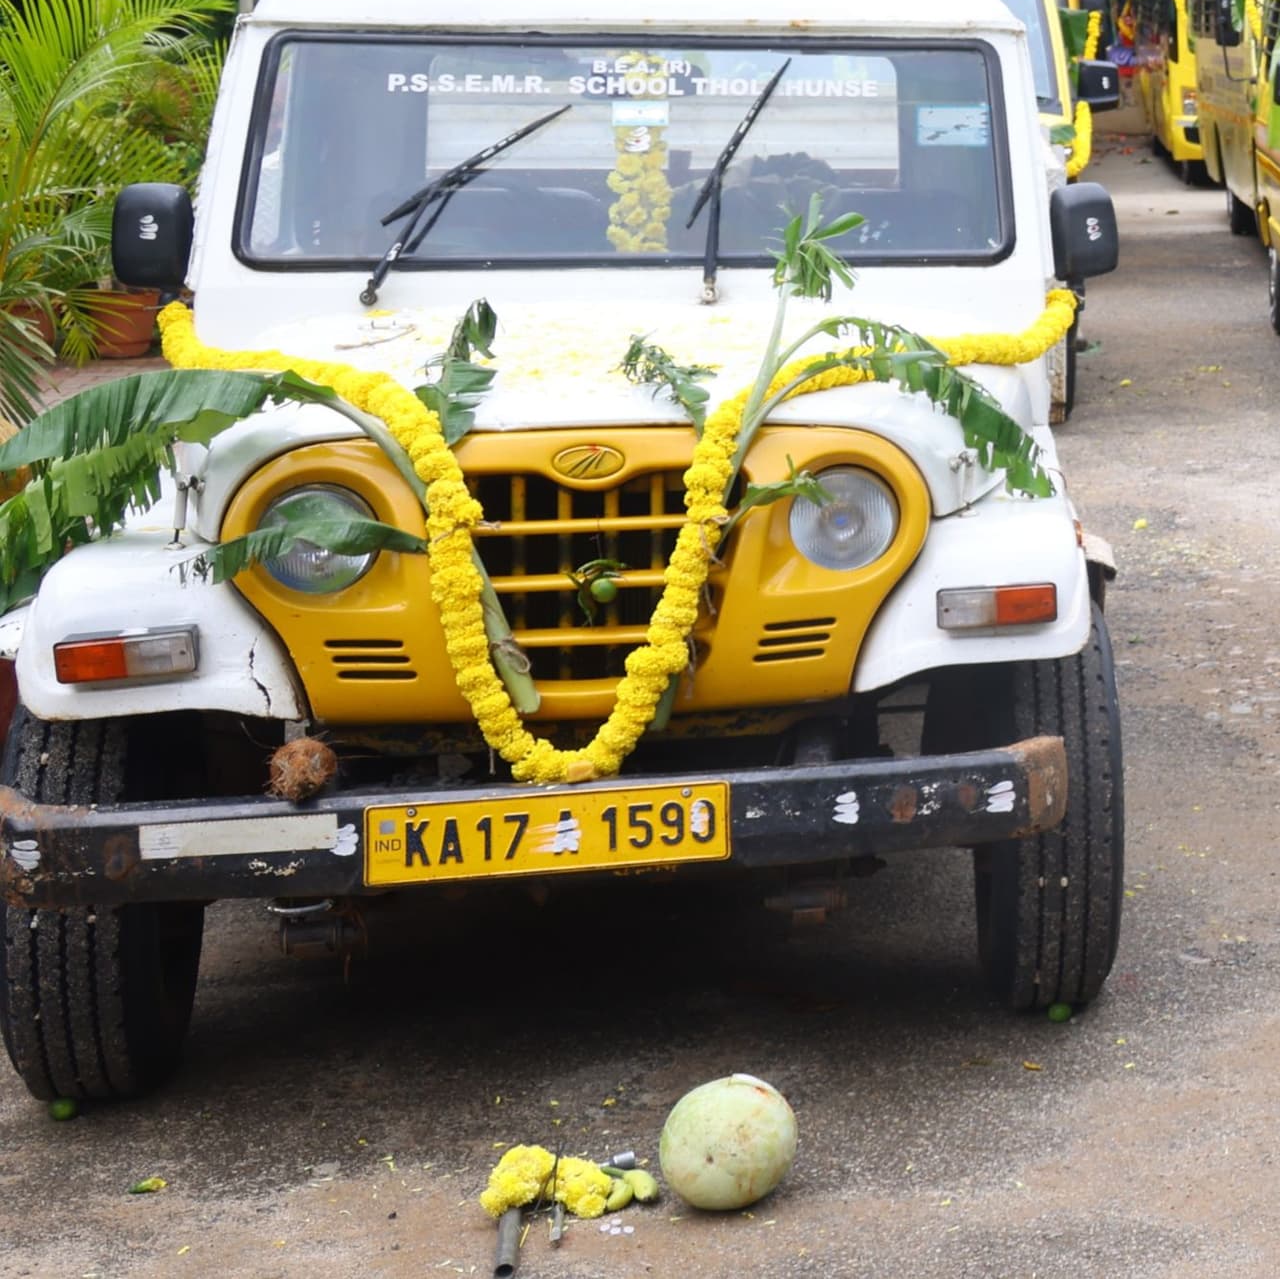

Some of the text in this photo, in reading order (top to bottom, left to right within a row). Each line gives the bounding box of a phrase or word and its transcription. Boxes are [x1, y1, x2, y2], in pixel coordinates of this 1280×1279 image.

[593, 59, 692, 76] B.E.A. (R)
[387, 73, 879, 98] P.S.S.E.M.R. SCHOOL THOLHUNSE
[404, 813, 530, 867] KA17
[601, 799, 717, 852] 1590
[374, 839, 401, 853] IND
